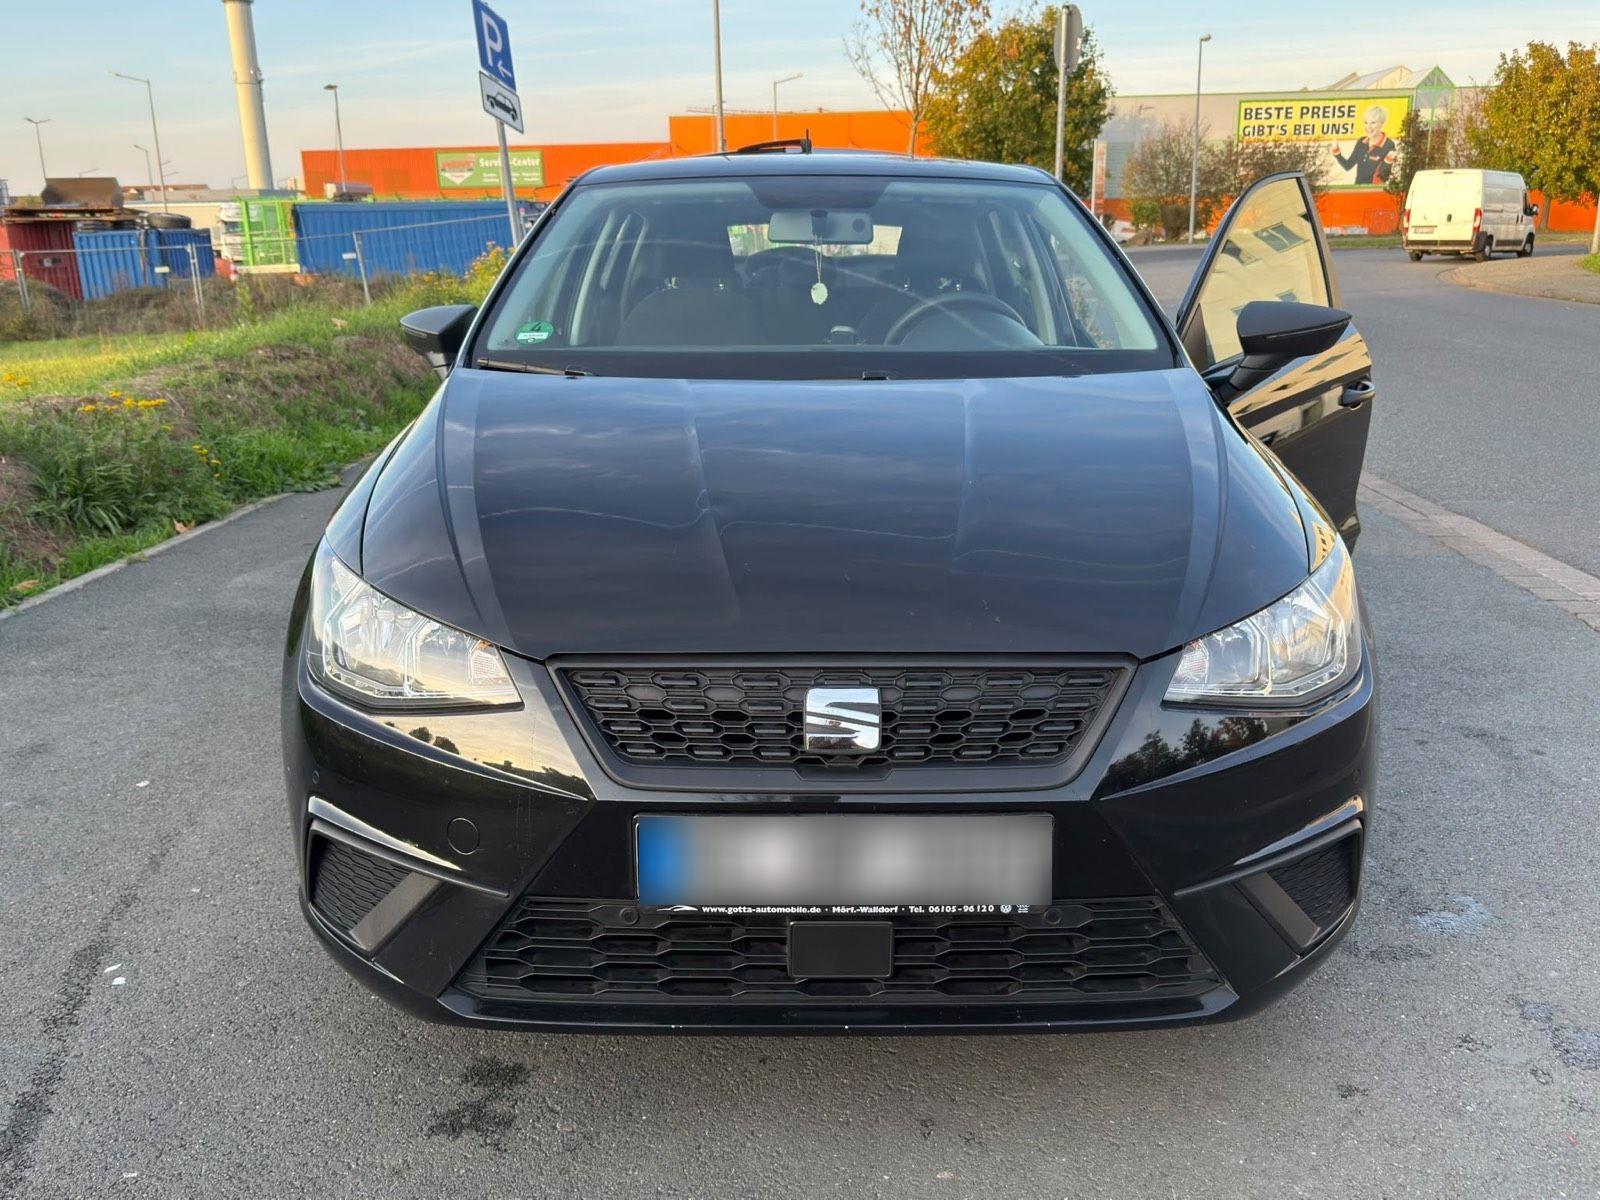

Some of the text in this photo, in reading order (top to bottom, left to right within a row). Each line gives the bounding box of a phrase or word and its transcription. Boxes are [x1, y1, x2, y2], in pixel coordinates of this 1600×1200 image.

[481, 10, 503, 66] P
[1244, 105, 1356, 120] BESTE PREISE
[1242, 123, 1354, 137] GIBT'S BEI UNS!
[702, 906, 821, 914] www.gotta-automobile.de
[909, 905, 924, 913] Tel.
